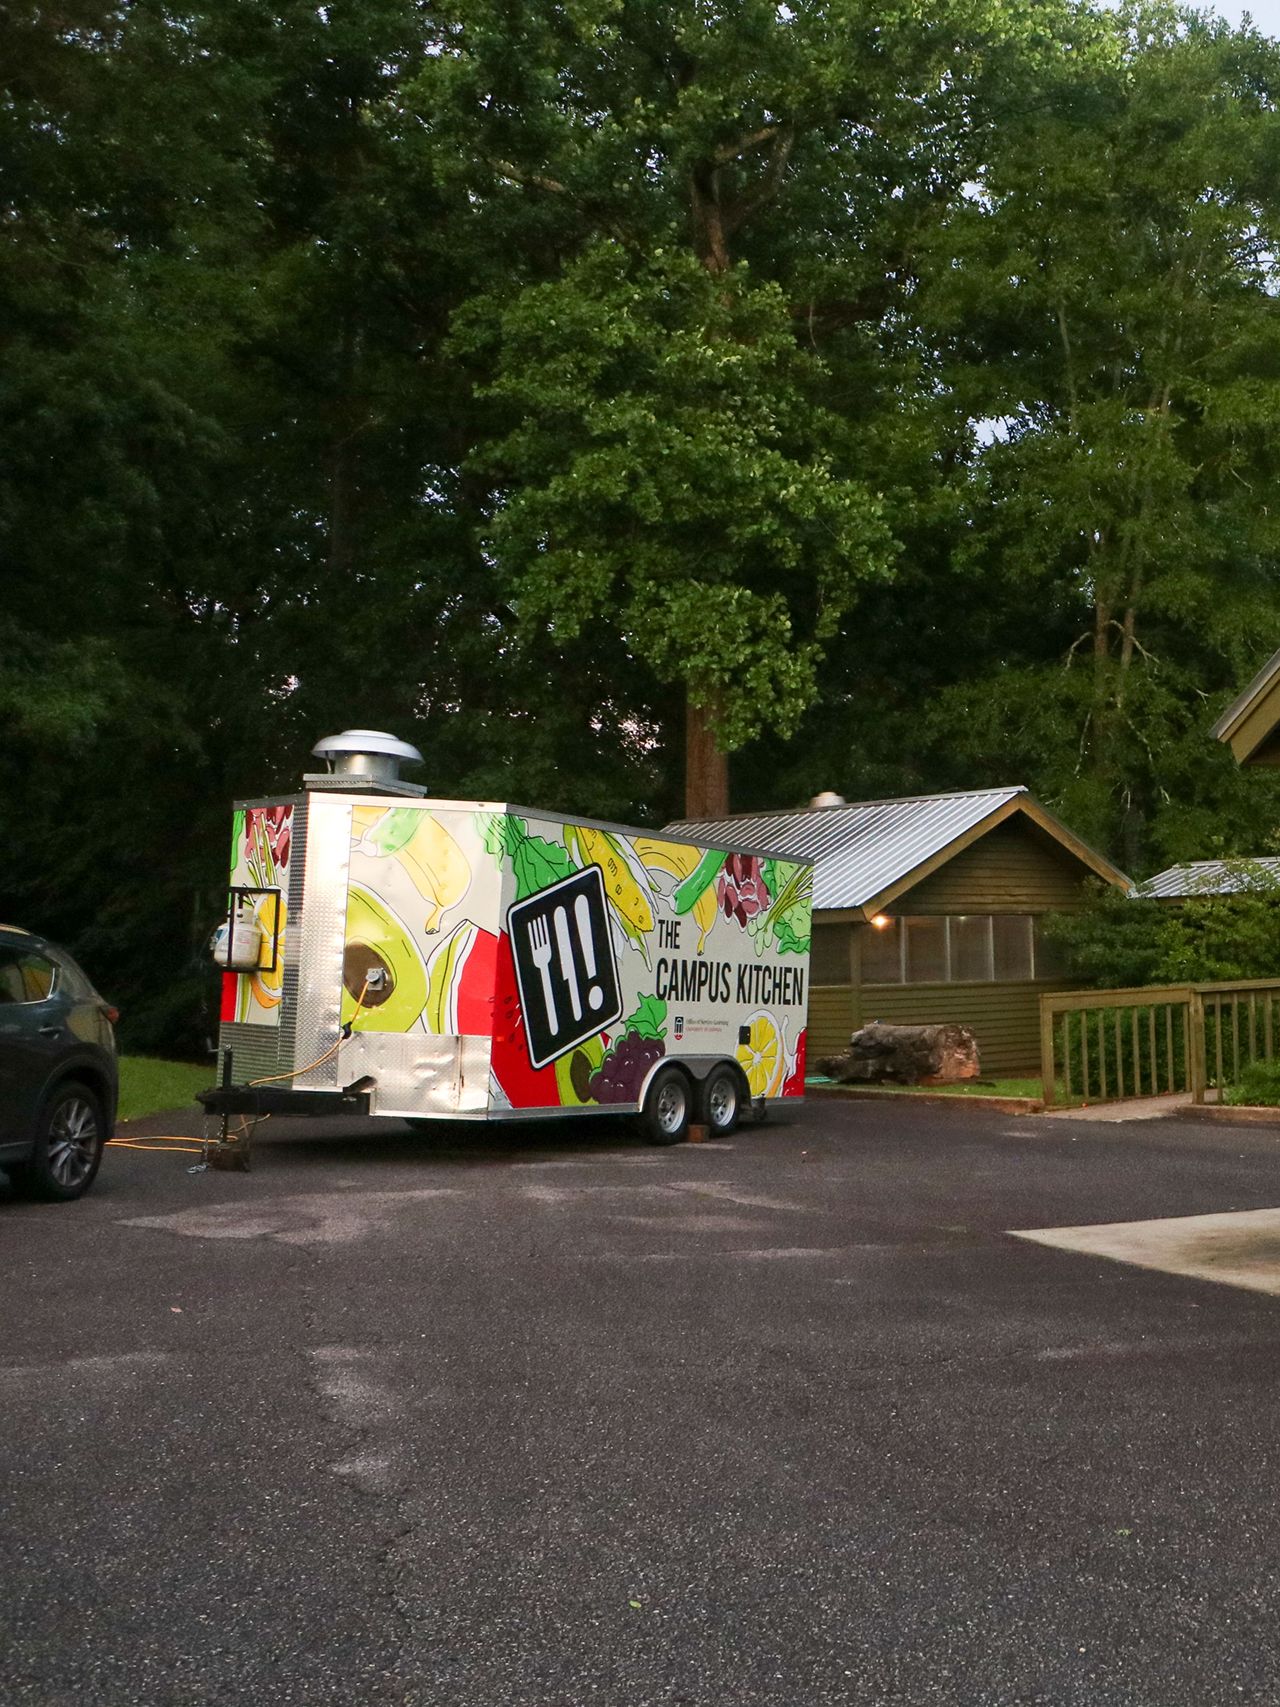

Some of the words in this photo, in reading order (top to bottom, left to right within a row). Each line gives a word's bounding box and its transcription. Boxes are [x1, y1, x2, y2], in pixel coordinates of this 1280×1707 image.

[658, 919, 681, 949] THE
[656, 958, 731, 1003] CAMPUS
[736, 964, 804, 1006] KITCHEN
